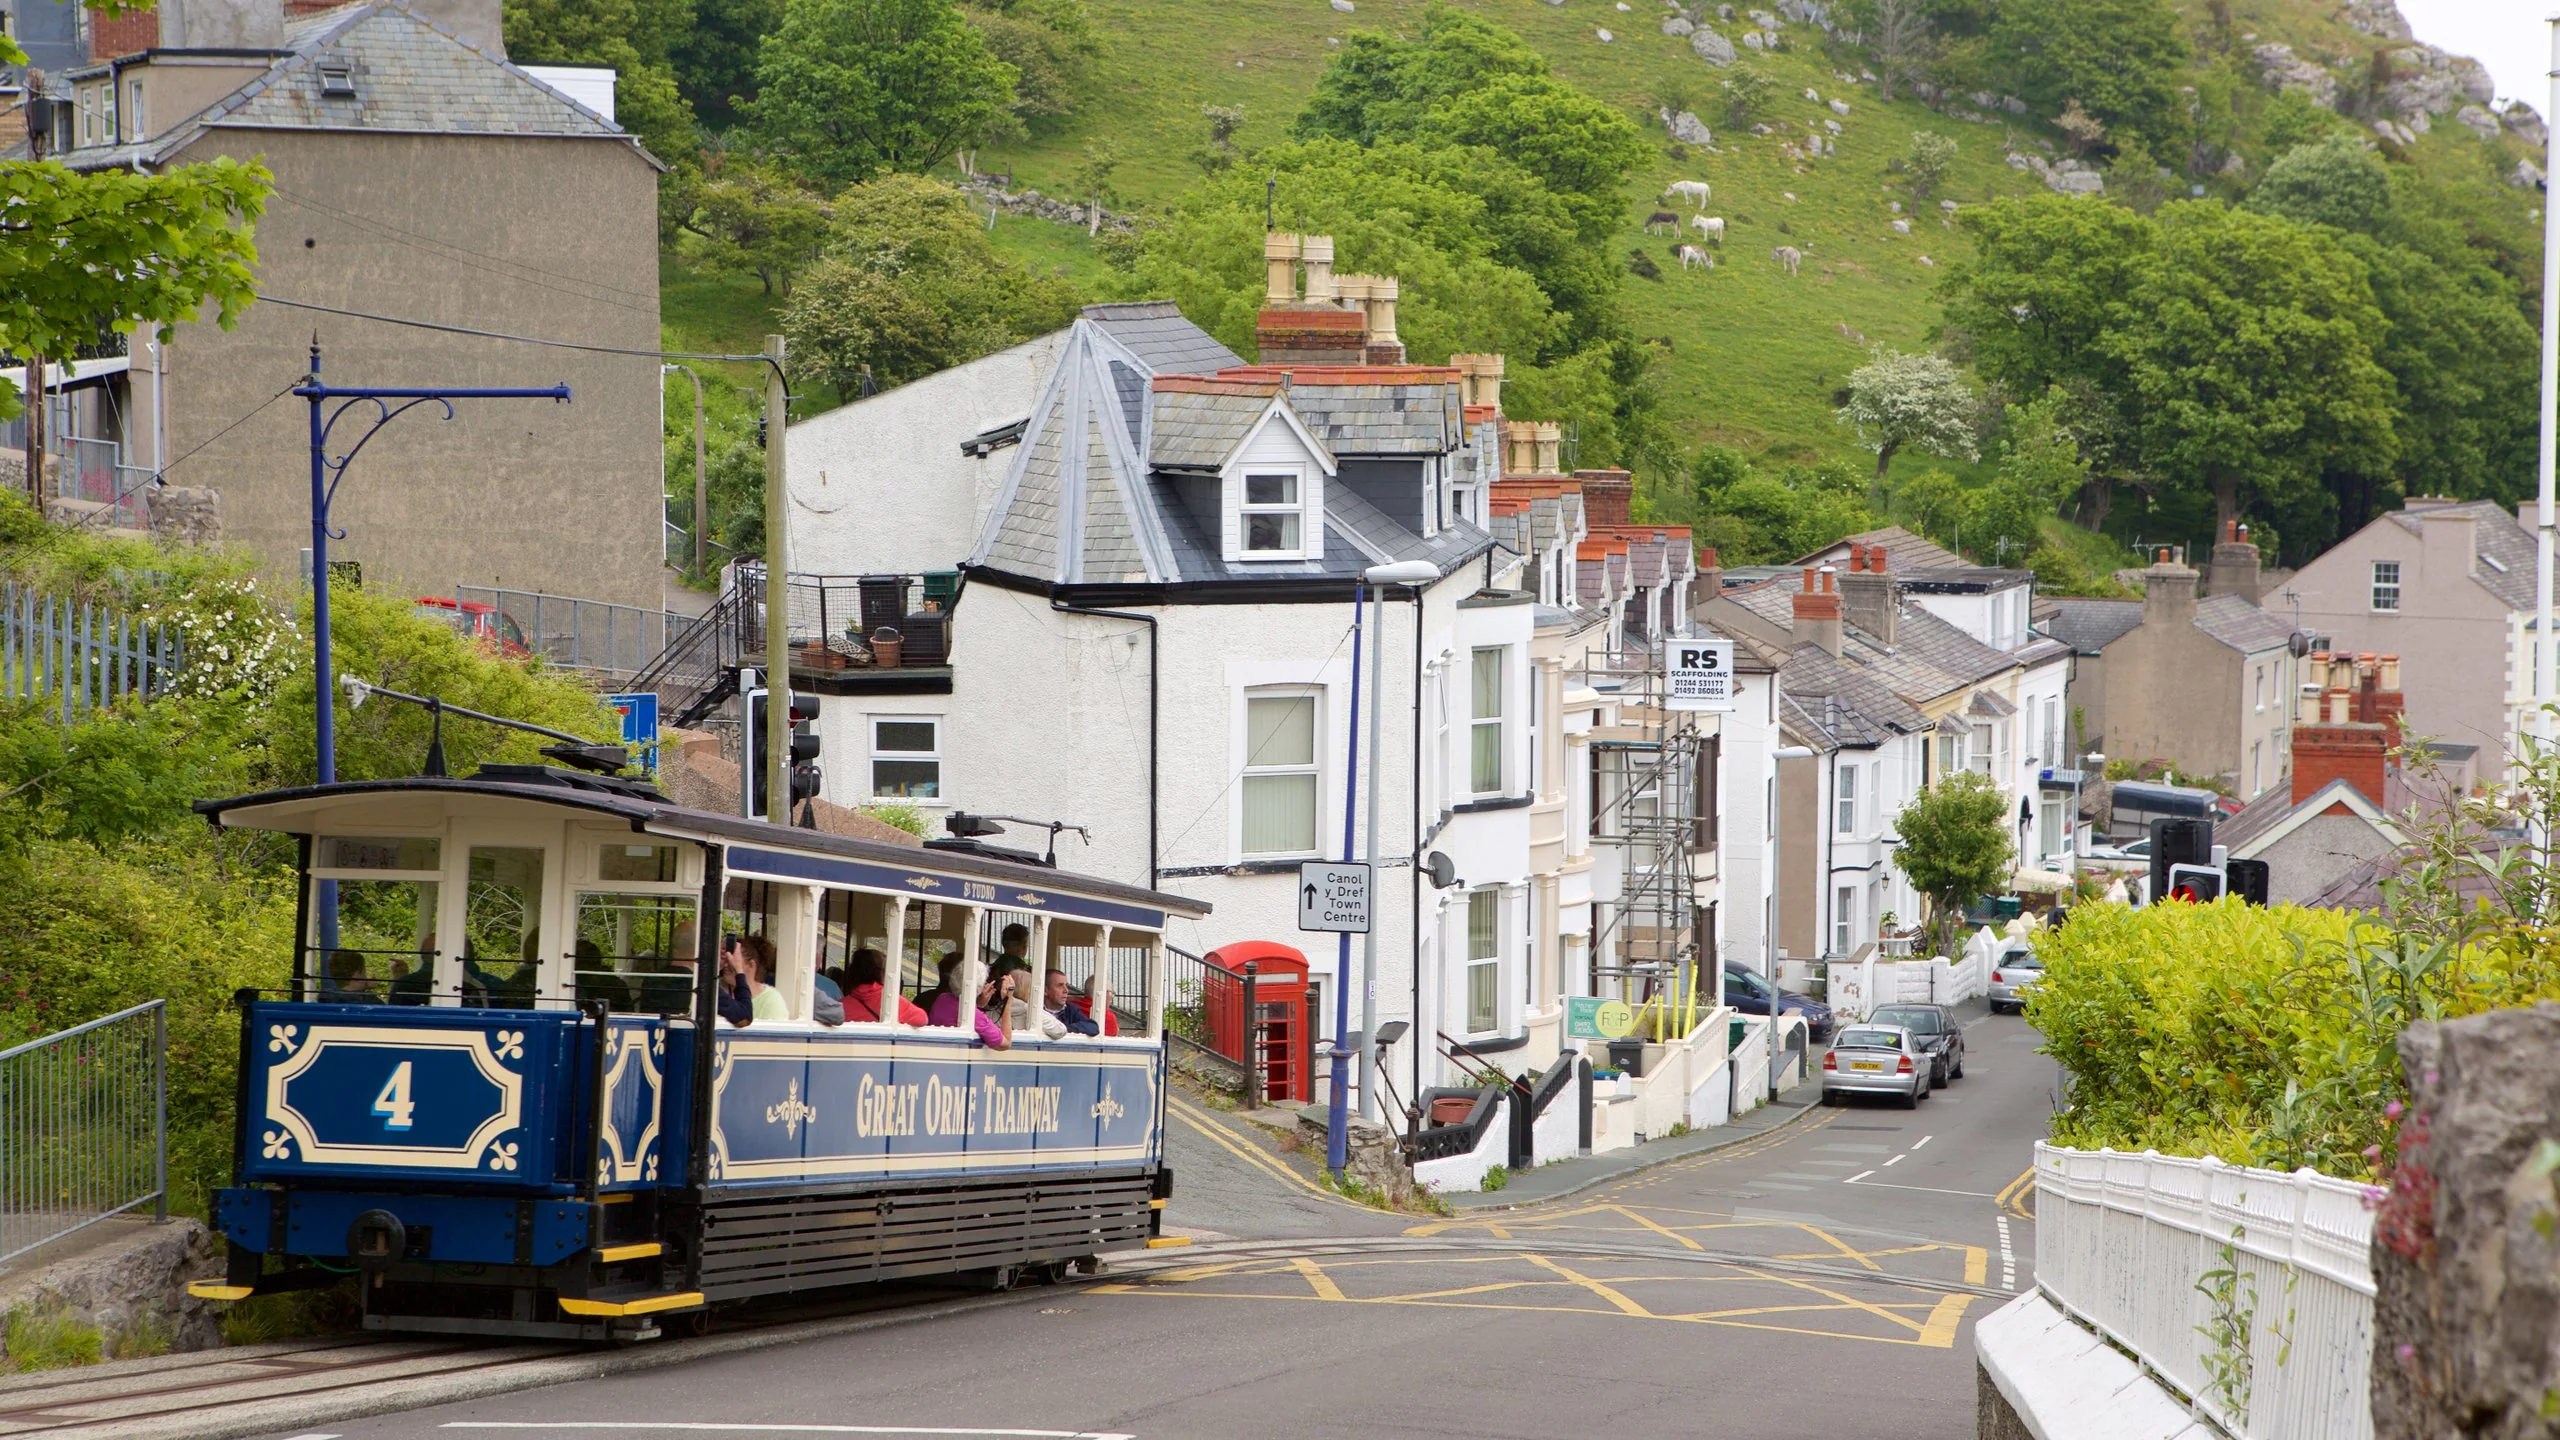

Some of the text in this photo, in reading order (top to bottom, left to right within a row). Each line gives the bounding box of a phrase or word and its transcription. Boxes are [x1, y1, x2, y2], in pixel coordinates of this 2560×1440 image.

[1681, 649, 1718, 669] RS
[1675, 679, 1696, 687] 01244
[1327, 872, 1362, 884] Canol
[972, 883, 996, 901] TUDNO
[1325, 887, 1364, 898] y Dref
[1329, 898, 1361, 909] Town
[1324, 911, 1366, 923] Centre
[370, 1061, 415, 1131] 4
